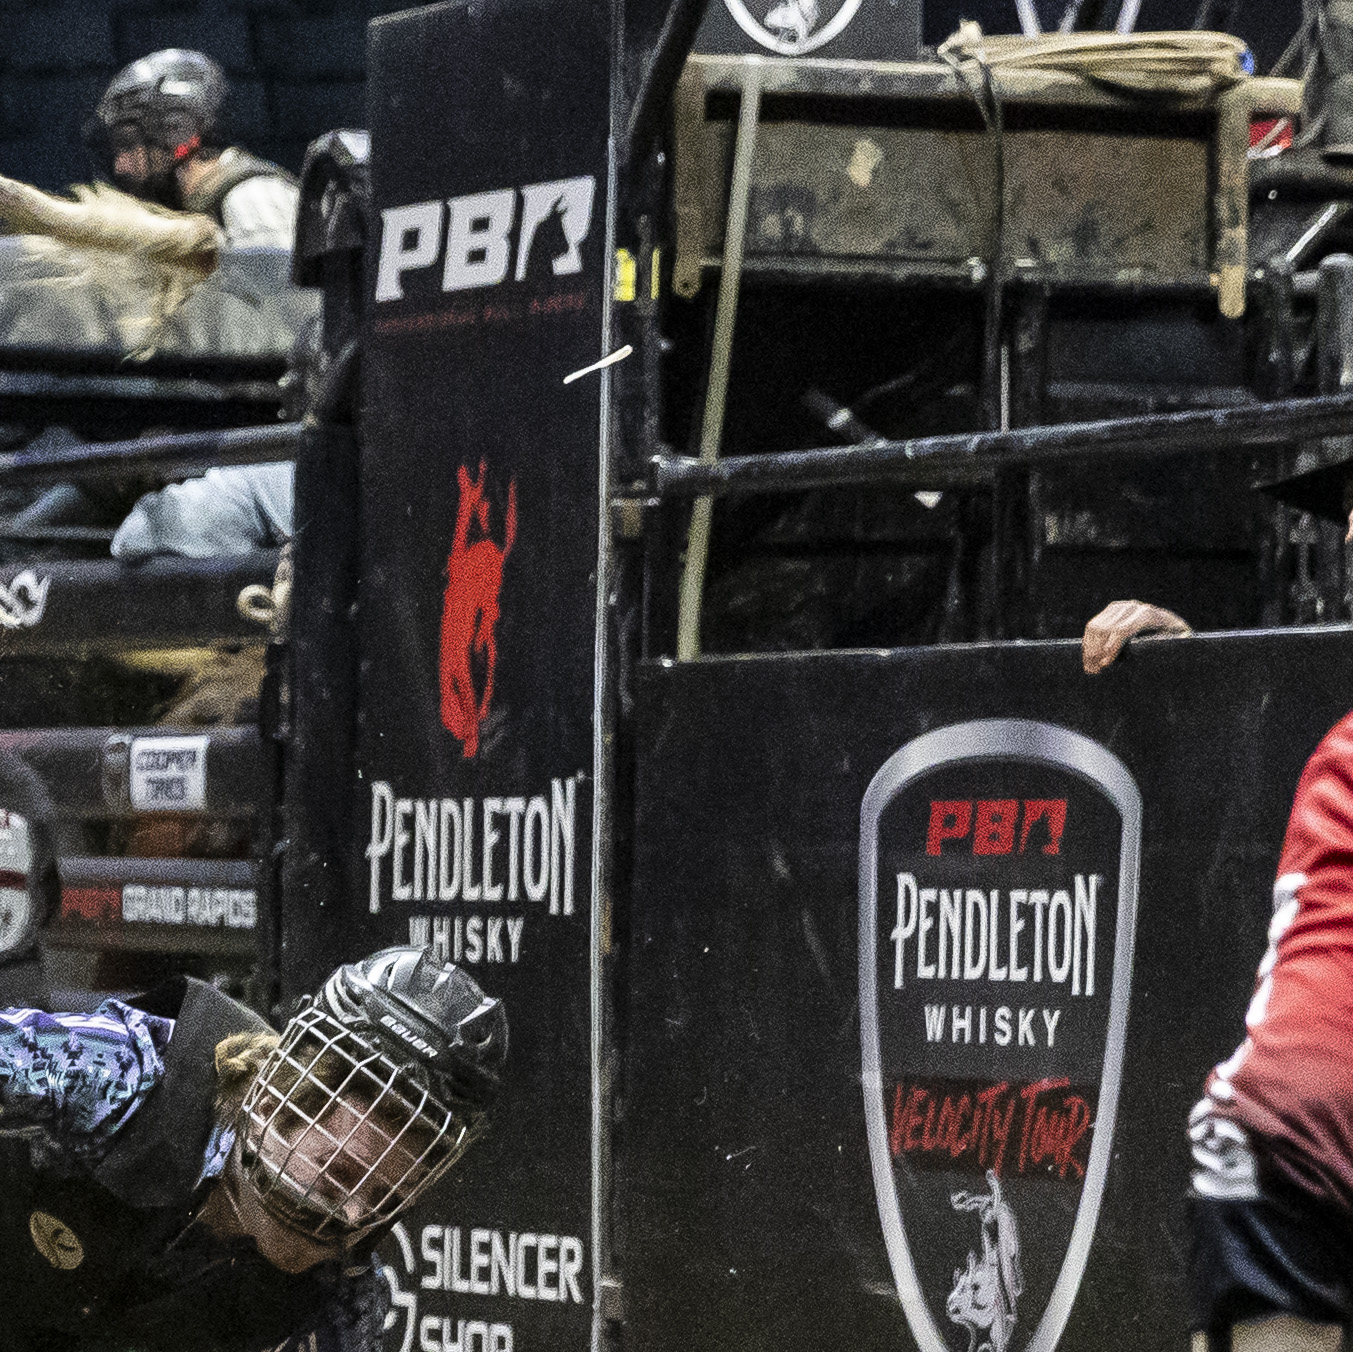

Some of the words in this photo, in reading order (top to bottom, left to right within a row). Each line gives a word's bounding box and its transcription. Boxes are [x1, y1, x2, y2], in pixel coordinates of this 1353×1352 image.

[365, 776, 576, 916] PENDLETON
[408, 915, 525, 964] WHISKY
[890, 871, 1100, 997] PENDLETON
[923, 1003, 1062, 1048] WHISKY
[890, 1080, 1015, 1178] VELOCITY
[1018, 1075, 1091, 1178] TOUR
[421, 1224, 585, 1304] SILENCER
